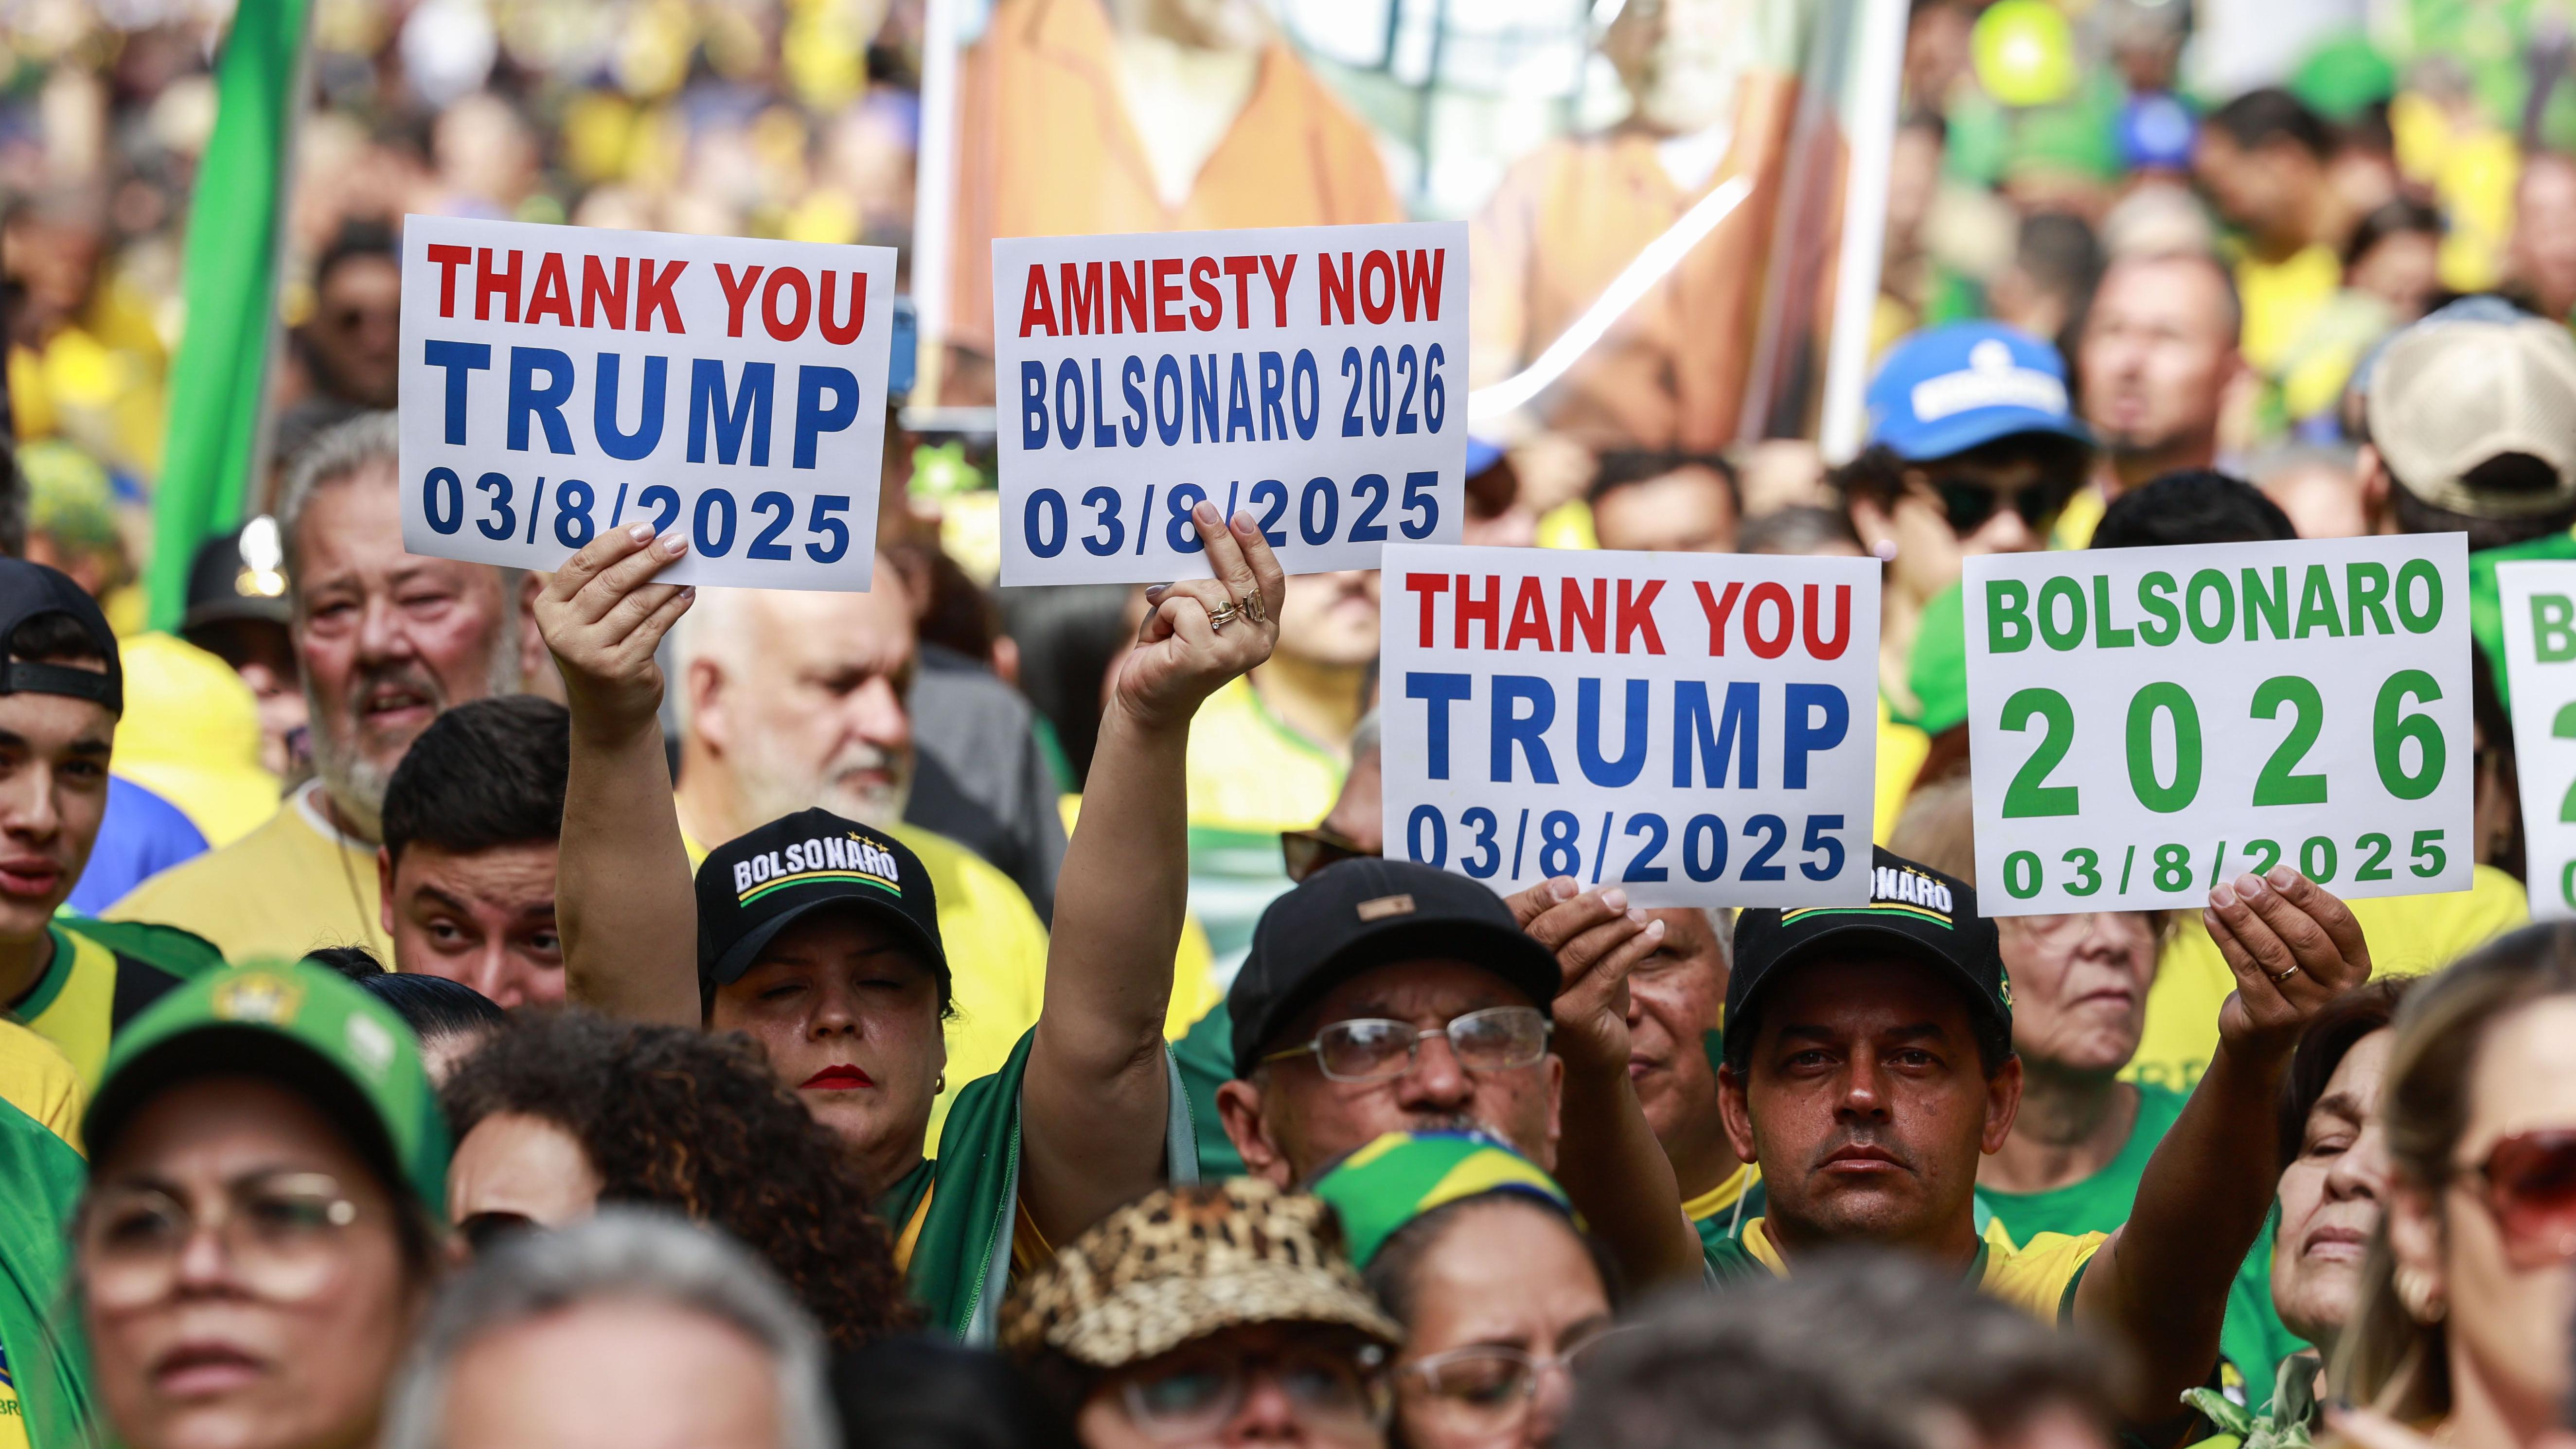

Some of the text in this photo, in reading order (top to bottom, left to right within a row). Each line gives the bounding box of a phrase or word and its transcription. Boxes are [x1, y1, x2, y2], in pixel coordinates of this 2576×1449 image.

[427, 244, 867, 345] THANK YOU
[1019, 248, 1445, 337] AMNESTY NOW
[425, 339, 859, 469] TRUMP
[1021, 343, 1445, 450] BOLSONARO 2026
[423, 467, 850, 564] 03/8/2025
[1024, 471, 1439, 558] 03/8/2025
[1406, 573, 1851, 660] THANK YOU
[1986, 559, 2443, 654] BOLSONARO
[1406, 672, 1849, 789] TRUMP
[2000, 670, 2446, 818] 2026
[733, 837, 899, 894] BOLSONARO
[1407, 804, 1845, 884] 03/8/2025
[2003, 830, 2446, 899] 03/8/2025
